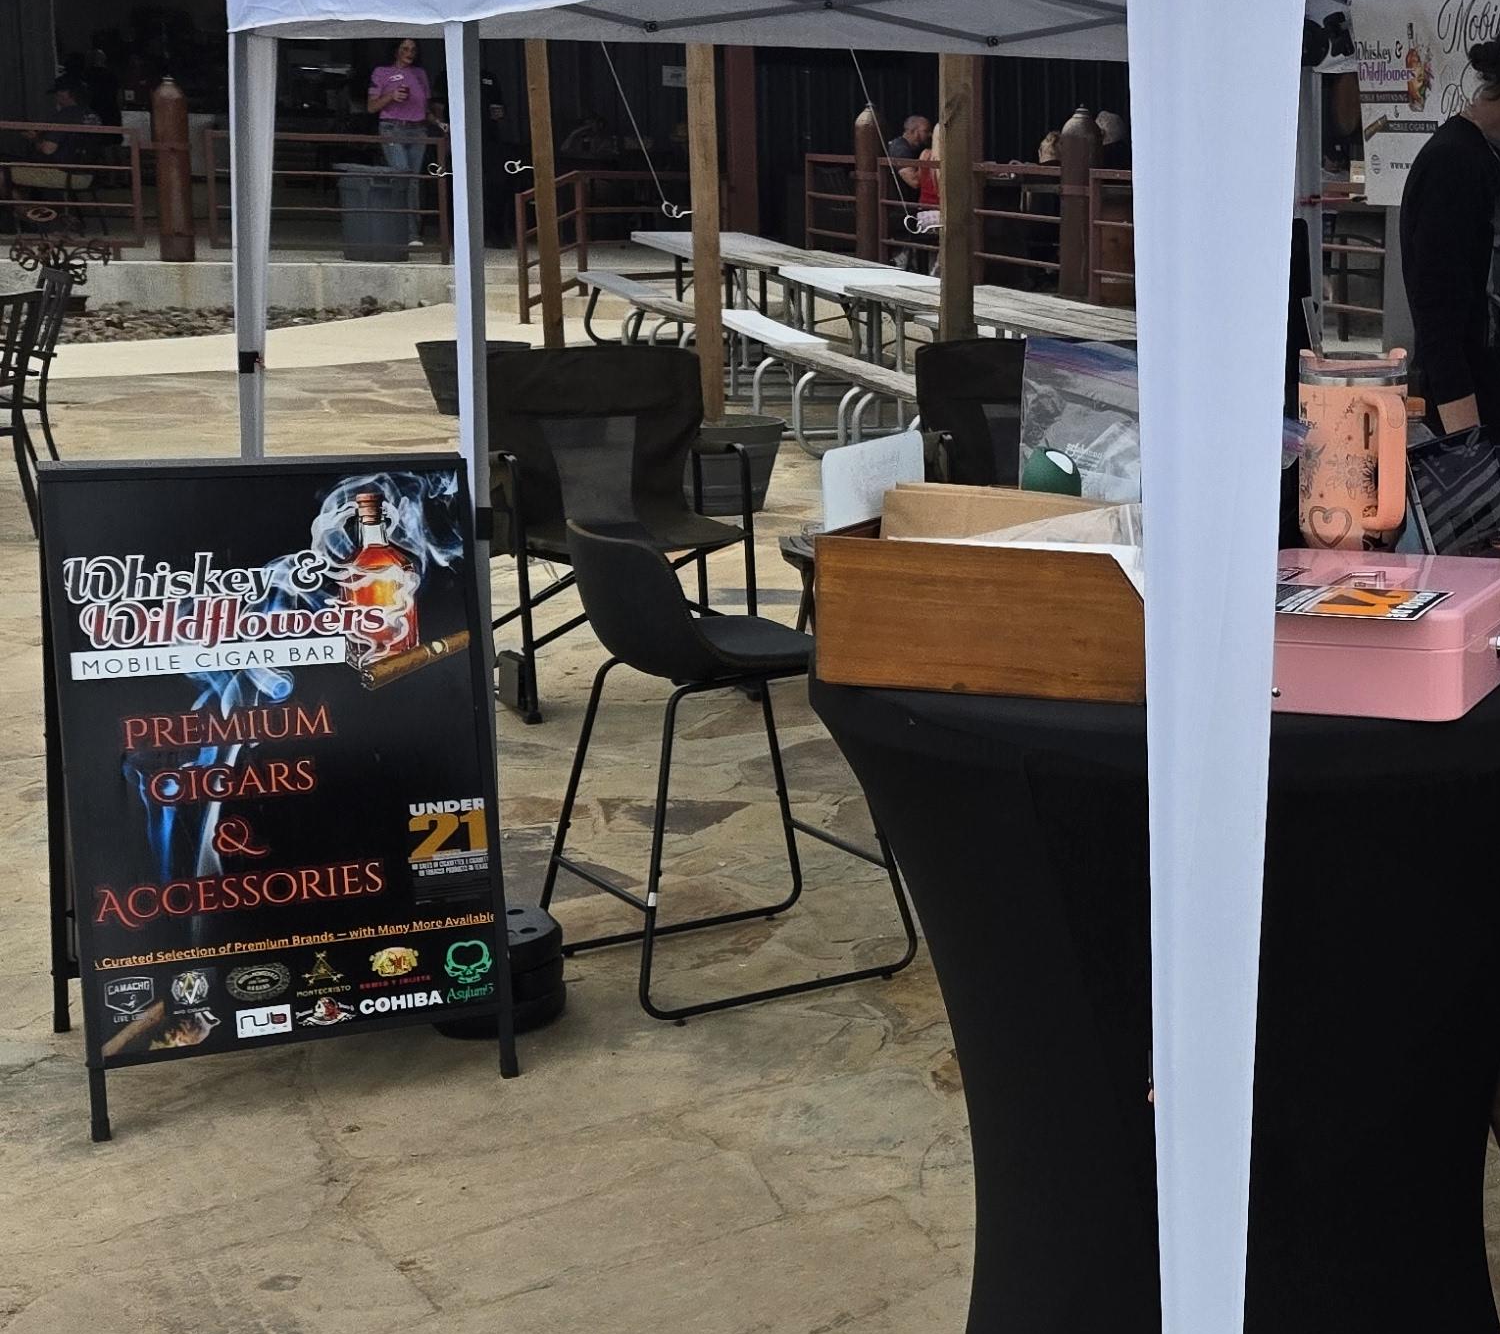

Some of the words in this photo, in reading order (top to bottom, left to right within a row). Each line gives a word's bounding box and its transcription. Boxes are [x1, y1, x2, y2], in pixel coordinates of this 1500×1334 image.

[63, 552, 275, 604] Whiskey
[290, 549, 332, 596] &
[80, 597, 386, 650] Wildflowers
[82, 654, 181, 675] MOBILE
[195, 649, 275, 668] CIGAR
[289, 645, 335, 662] BAR
[123, 704, 335, 750] PREMIUM
[150, 760, 315, 803] CIGARS
[408, 797, 485, 816] UNDER
[215, 820, 268, 856] &
[408, 810, 488, 861] 21
[95, 862, 384, 928] ACCESSORIES
[102, 952, 153, 968] Curated
[156, 946, 216, 962] Selection
[218, 942, 232, 955] of
[234, 937, 289, 953] Premium
[292, 931, 335, 946] Brands
[350, 925, 375, 939] with
[377, 923, 410, 936] Many
[412, 919, 443, 931] More
[106, 980, 150, 996] CAMACHO
[296, 984, 352, 997] MONTECRISTO
[359, 990, 444, 1015] COHIBA
